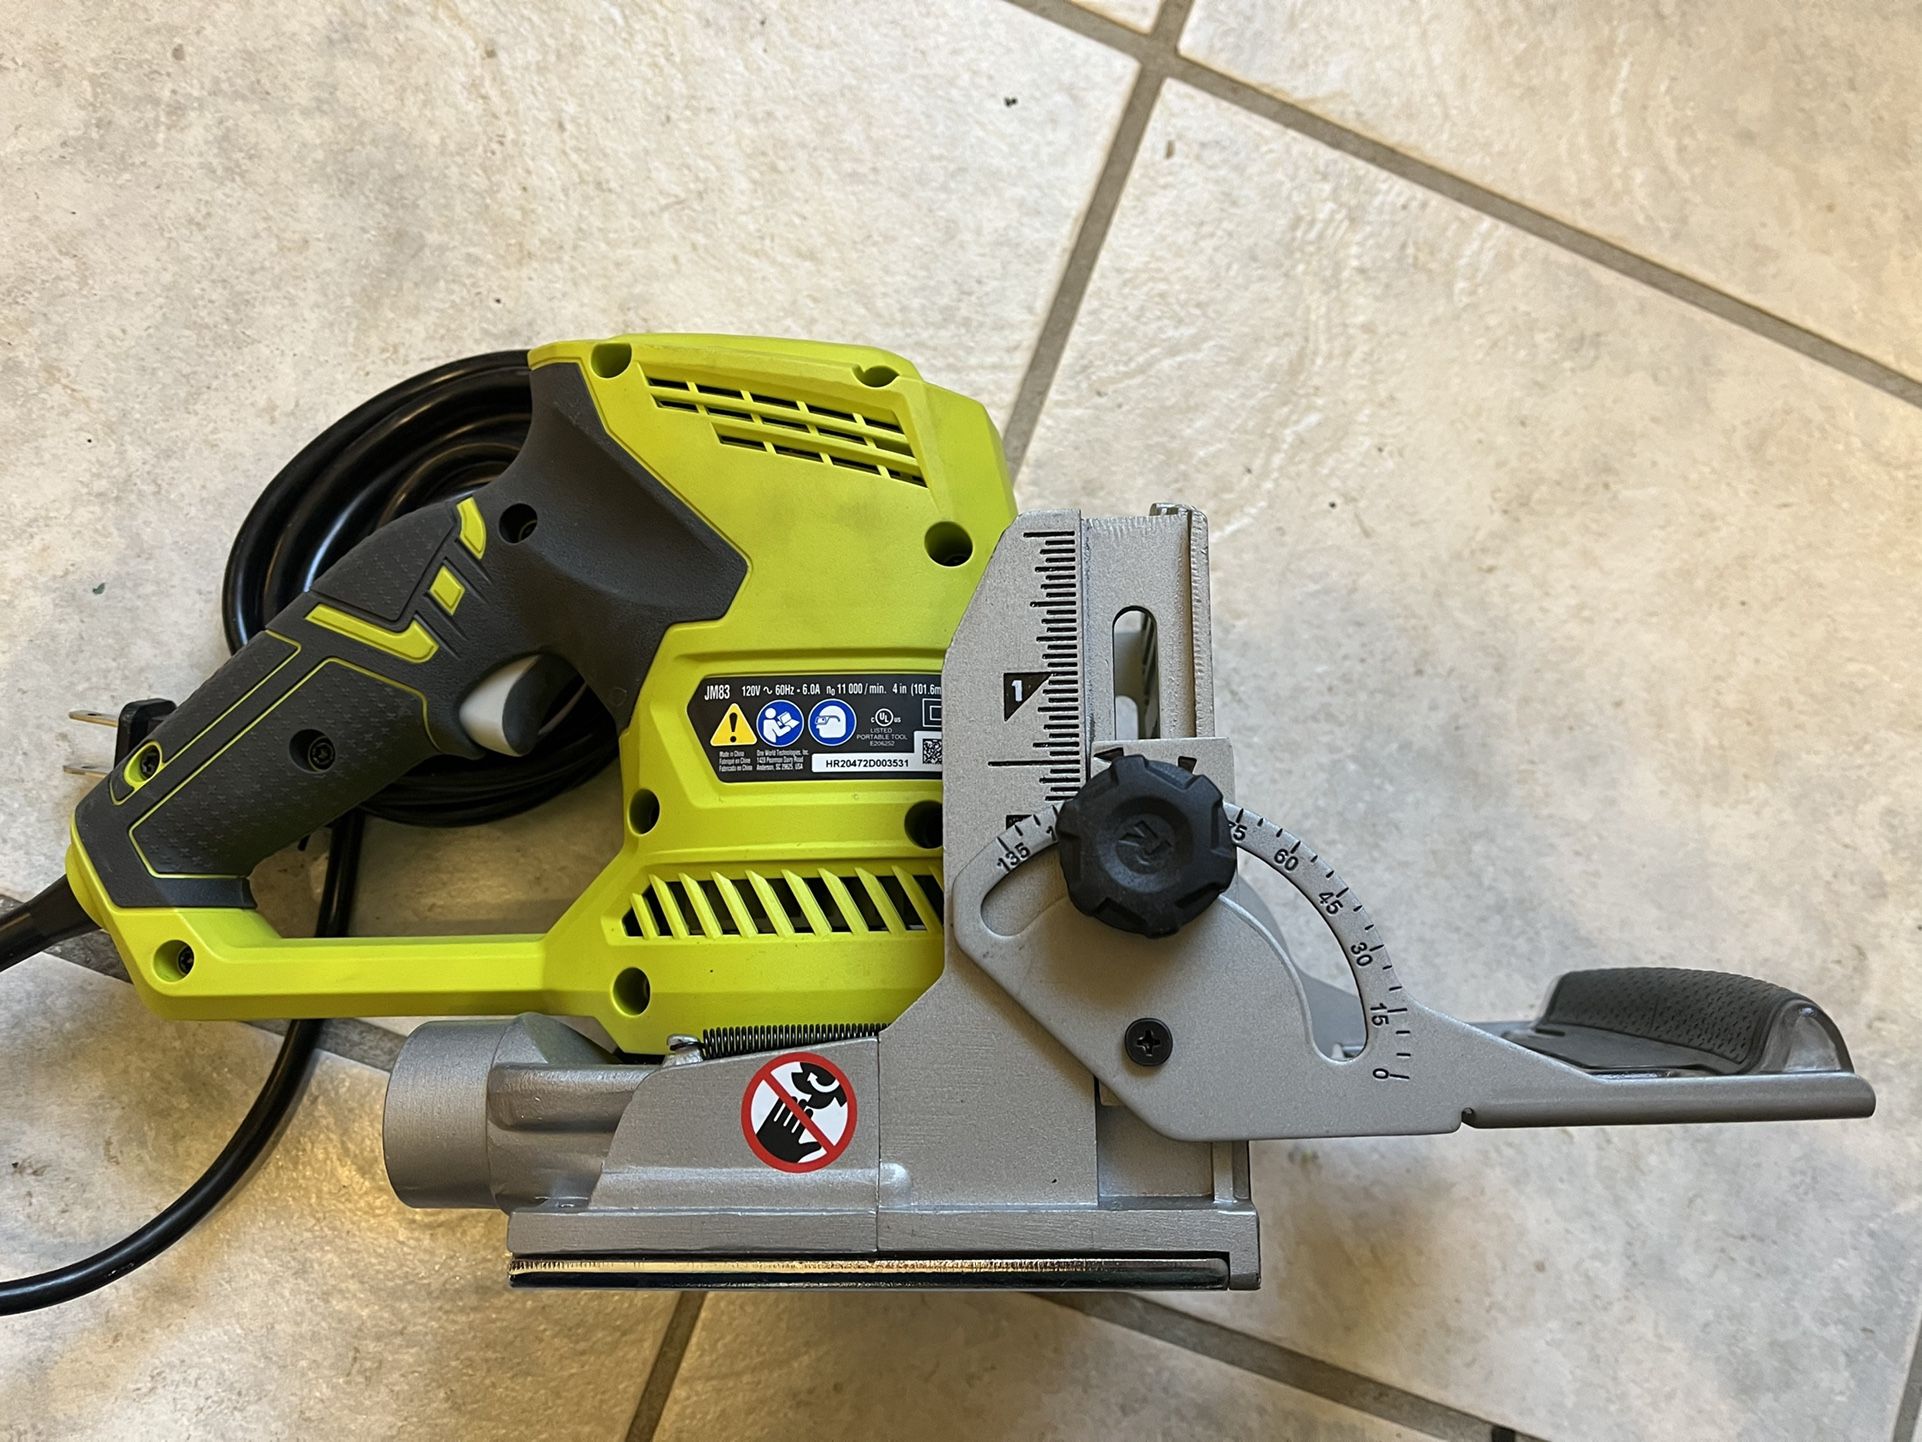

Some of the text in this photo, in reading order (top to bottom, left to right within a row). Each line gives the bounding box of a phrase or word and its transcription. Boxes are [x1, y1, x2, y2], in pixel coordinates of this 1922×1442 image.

[704, 684, 730, 700] JM83
[742, 685, 760, 696] 120V
[775, 684, 794, 695] 60Hz
[802, 683, 820, 695] 6.0A
[892, 683, 898, 694] 4
[900, 683, 907, 694] in
[1011, 680, 1023, 702] 1
[826, 759, 909, 768] HR20472D003531
[997, 842, 1031, 871] 135
[1273, 848, 1299, 872] 60
[1318, 890, 1344, 915] 45
[1350, 942, 1373, 967] 30
[1370, 1002, 1390, 1027] 15
[1372, 1068, 1390, 1080] 0
